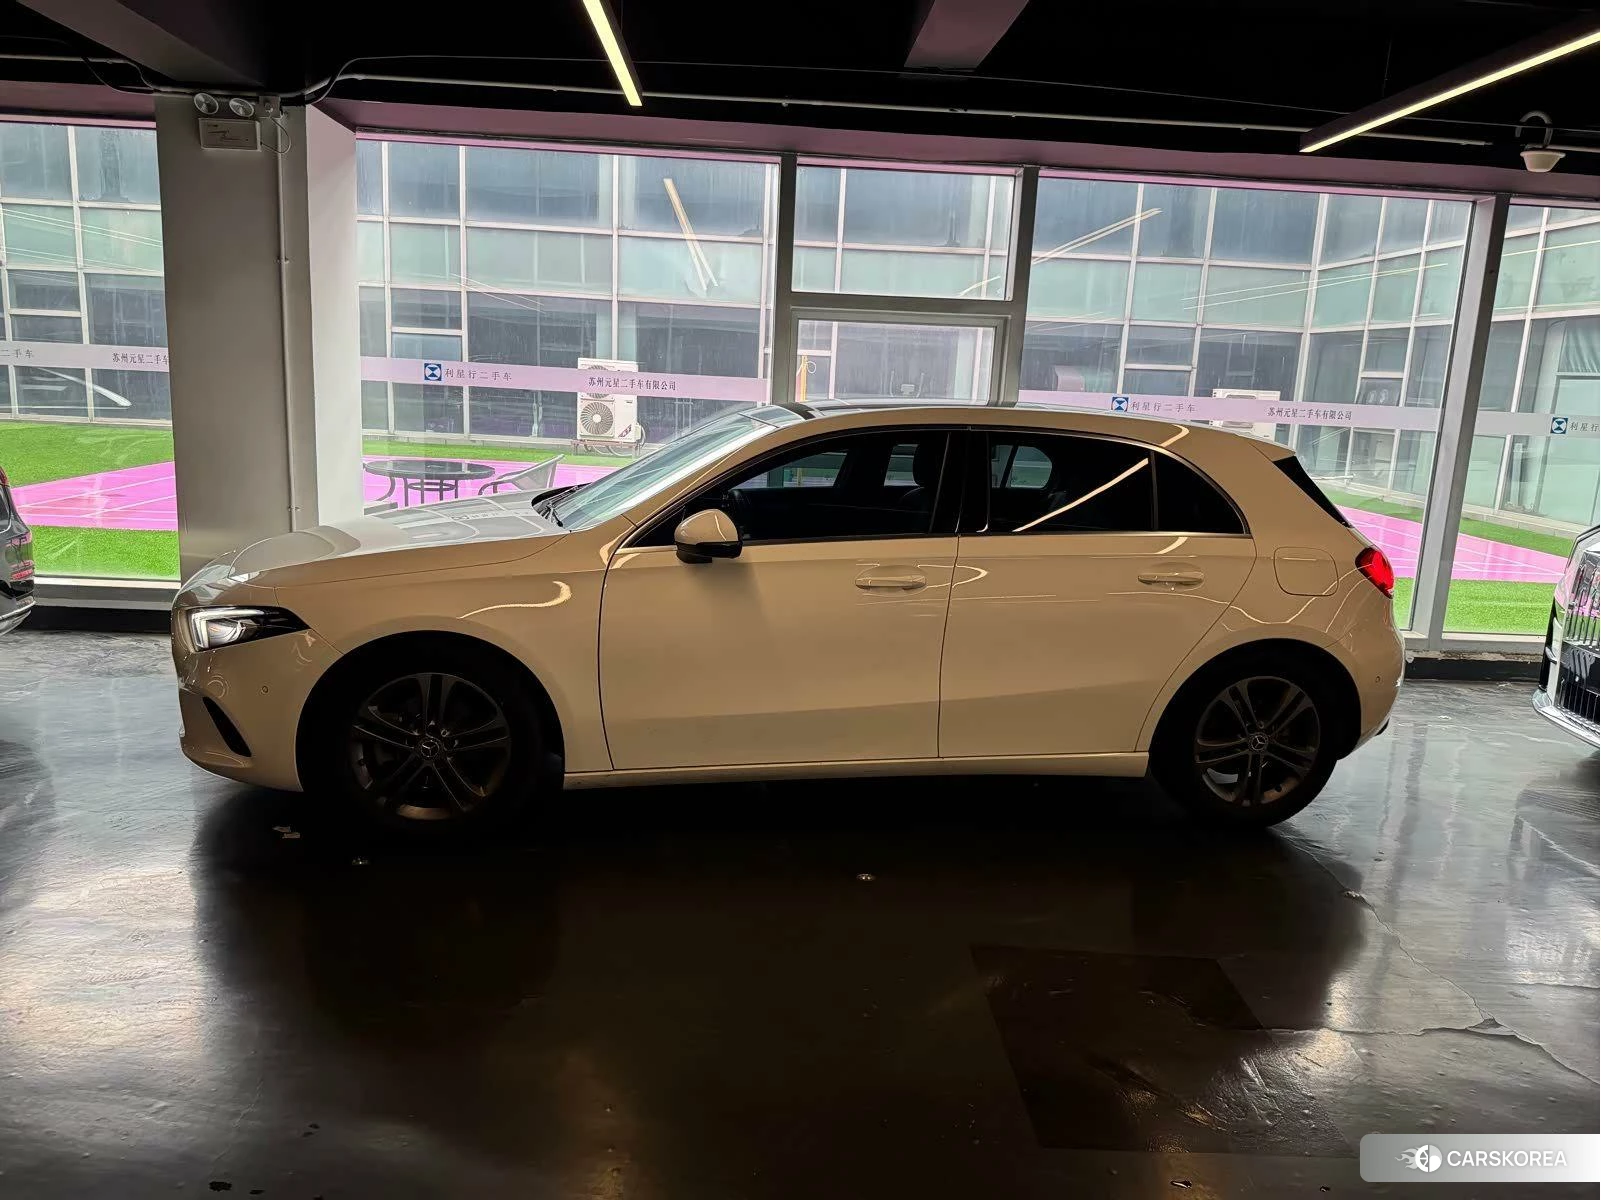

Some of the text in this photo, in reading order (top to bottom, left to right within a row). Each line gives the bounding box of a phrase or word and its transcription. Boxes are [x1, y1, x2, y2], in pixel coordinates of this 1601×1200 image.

[444, 368, 512, 382] 利星行二手车
[588, 377, 676, 391] 苏州元星二手车有限公司
[1131, 401, 1196, 413] 利星行二手车
[1267, 407, 1352, 421] 苏州元星二手车有限公司
